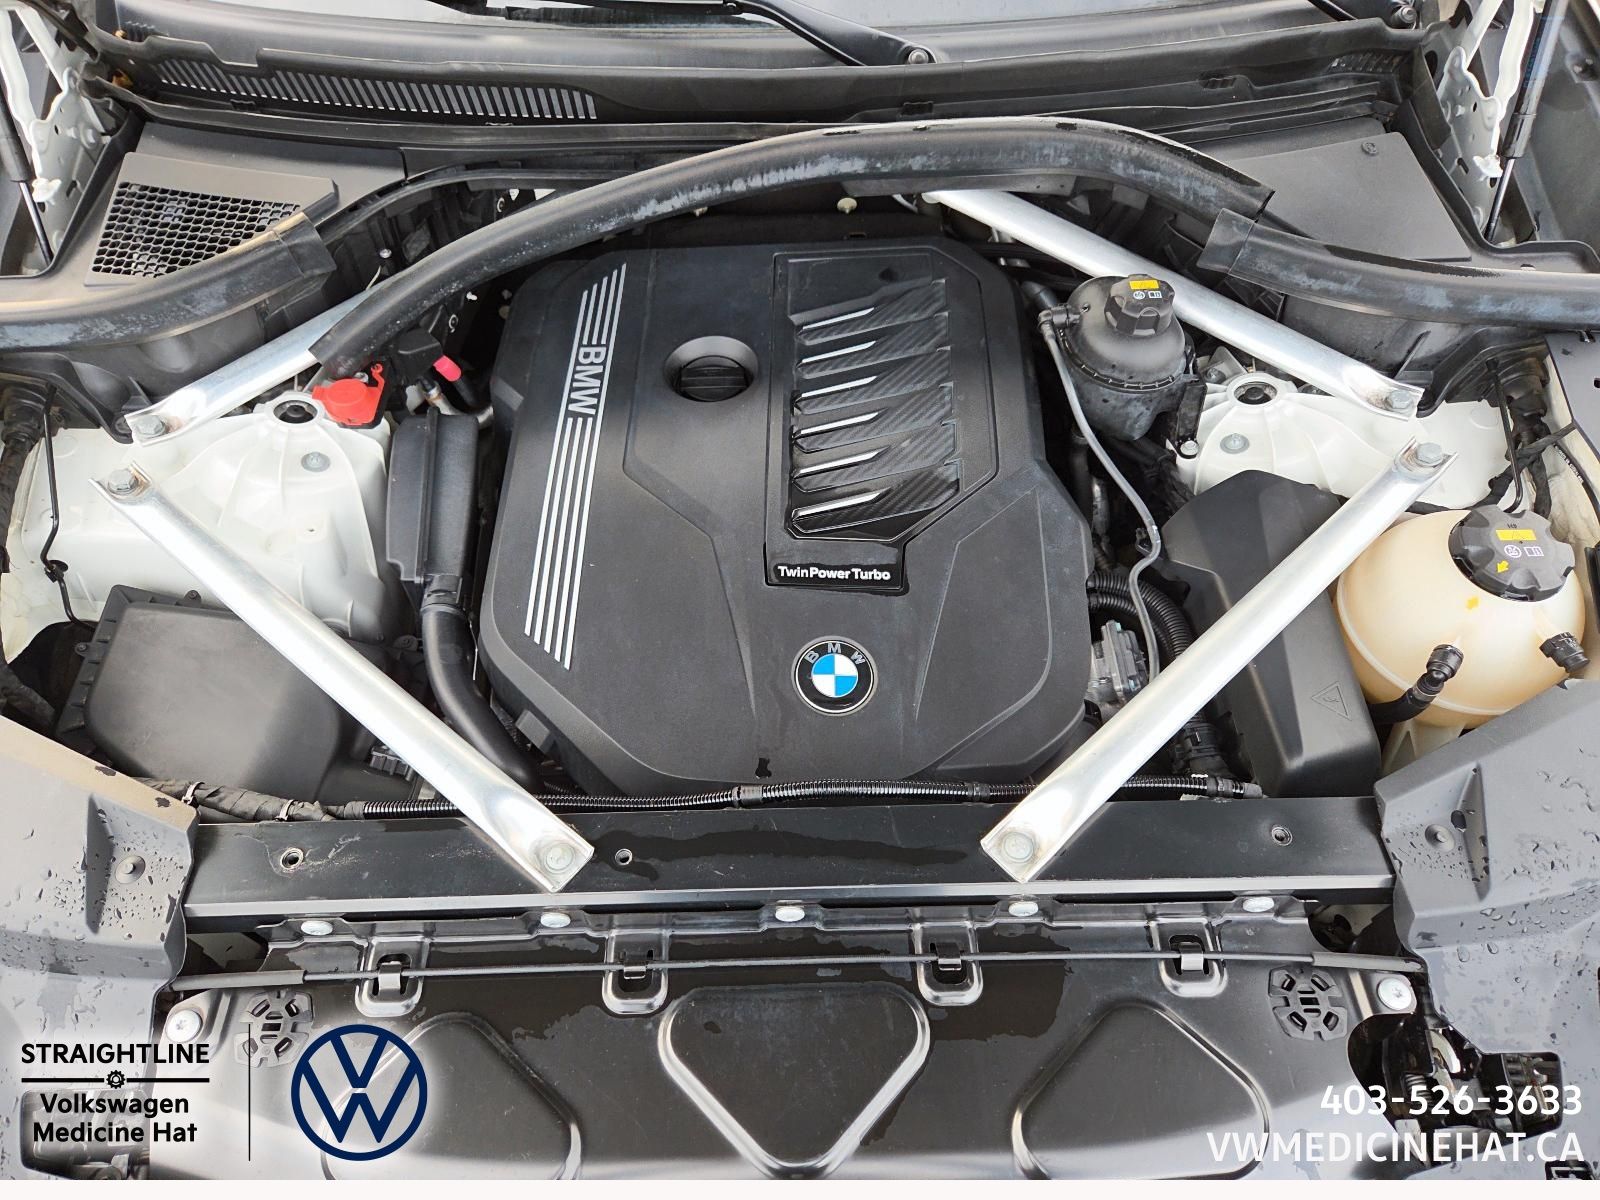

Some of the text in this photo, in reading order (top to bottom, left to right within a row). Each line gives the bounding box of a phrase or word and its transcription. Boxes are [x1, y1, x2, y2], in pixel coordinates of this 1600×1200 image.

[567, 346, 607, 415] BMW
[851, 568, 891, 580] Turbo
[804, 642, 866, 665] BMW
